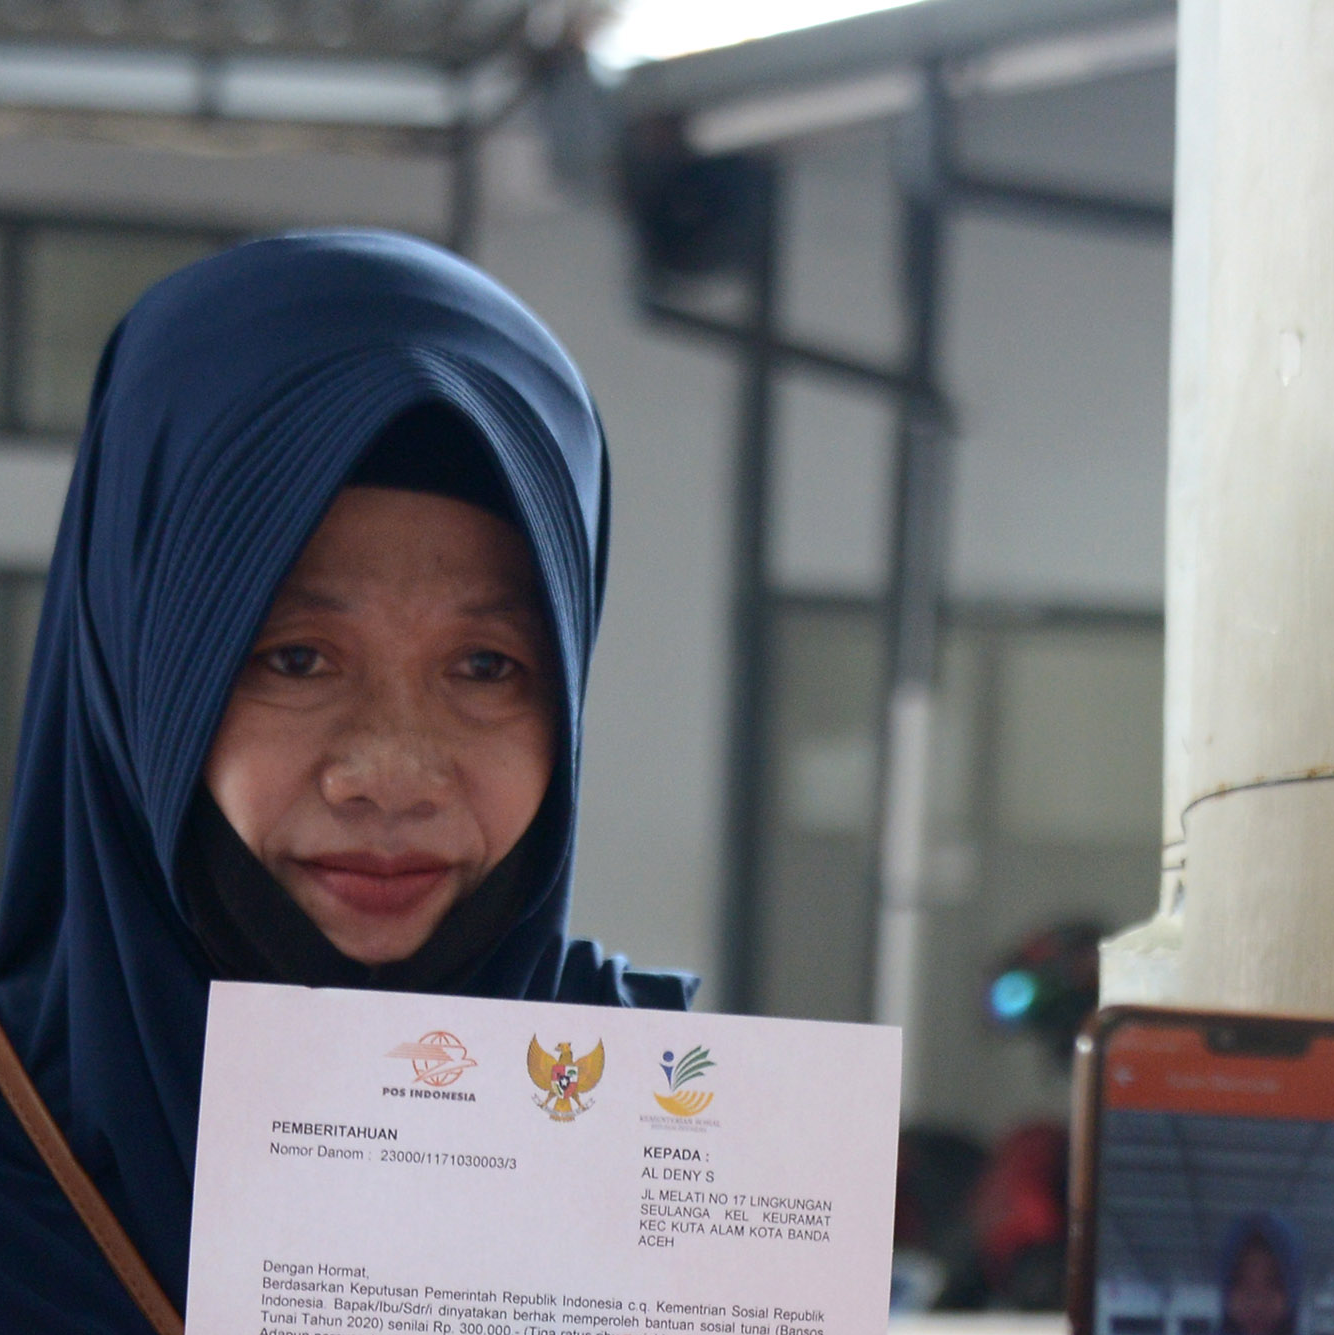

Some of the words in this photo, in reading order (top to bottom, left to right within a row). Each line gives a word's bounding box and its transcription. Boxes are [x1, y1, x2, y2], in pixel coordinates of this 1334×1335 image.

[382, 1087, 406, 1098] POS
[410, 1089, 477, 1102] INDONESIA
[271, 1120, 398, 1141] PEMBERITAHUAN
[270, 1142, 313, 1157] Nomor
[317, 1145, 364, 1160] Danom
[380, 1149, 517, 1170] 23000/1171030003/3
[643, 1146, 701, 1161] KEPADA
[641, 1167, 658, 1179] AL
[663, 1168, 701, 1182] DENY
[705, 1171, 715, 1183] S
[641, 1189, 655, 1200] JL
[659, 1190, 704, 1203] MELATI
[709, 1193, 728, 1205] NO
[733, 1195, 746, 1206] 17
[750, 1196, 832, 1211] LINGKUNGAN
[640, 1204, 710, 1219] SEULANGA
[725, 1210, 749, 1222] KEL
[763, 1212, 831, 1226] KEURAMAT
[638, 1235, 675, 1248] ACEH
[639, 1220, 666, 1232] KEC
[671, 1221, 705, 1234] KUTA
[709, 1225, 745, 1236] ALAM
[749, 1227, 783, 1239] KOTA
[788, 1229, 830, 1242] BANDA
[263, 1260, 314, 1277] Dengan
[318, 1263, 369, 1280] Hormat,
[262, 1277, 344, 1294] Berdasarkan
[350, 1282, 419, 1299] Keputusan
[424, 1286, 497, 1303] Pemerintah
[503, 1291, 557, 1307] Republik
[563, 1295, 623, 1311] Indonesia
[656, 1301, 727, 1318] Kementrian
[731, 1304, 768, 1319] Sosial
[773, 1307, 825, 1323] Republik
[260, 1311, 297, 1324] Tunai
[301, 1313, 343, 1328] Tahun
[347, 1316, 384, 1332] 2020)
[388, 1318, 429, 1332] senilai
[433, 1321, 455, 1335] Rp.
[334, 1297, 433, 1316] Bapak/Ibu/Sdr/i
[438, 1304, 507, 1320] dinyatakan
[513, 1310, 556, 1323] berhak
[562, 1312, 639, 1328] memperoleh
[645, 1316, 694, 1331] bantuan
[700, 1320, 736, 1334] sosial
[740, 1323, 770, 1335] tunai
